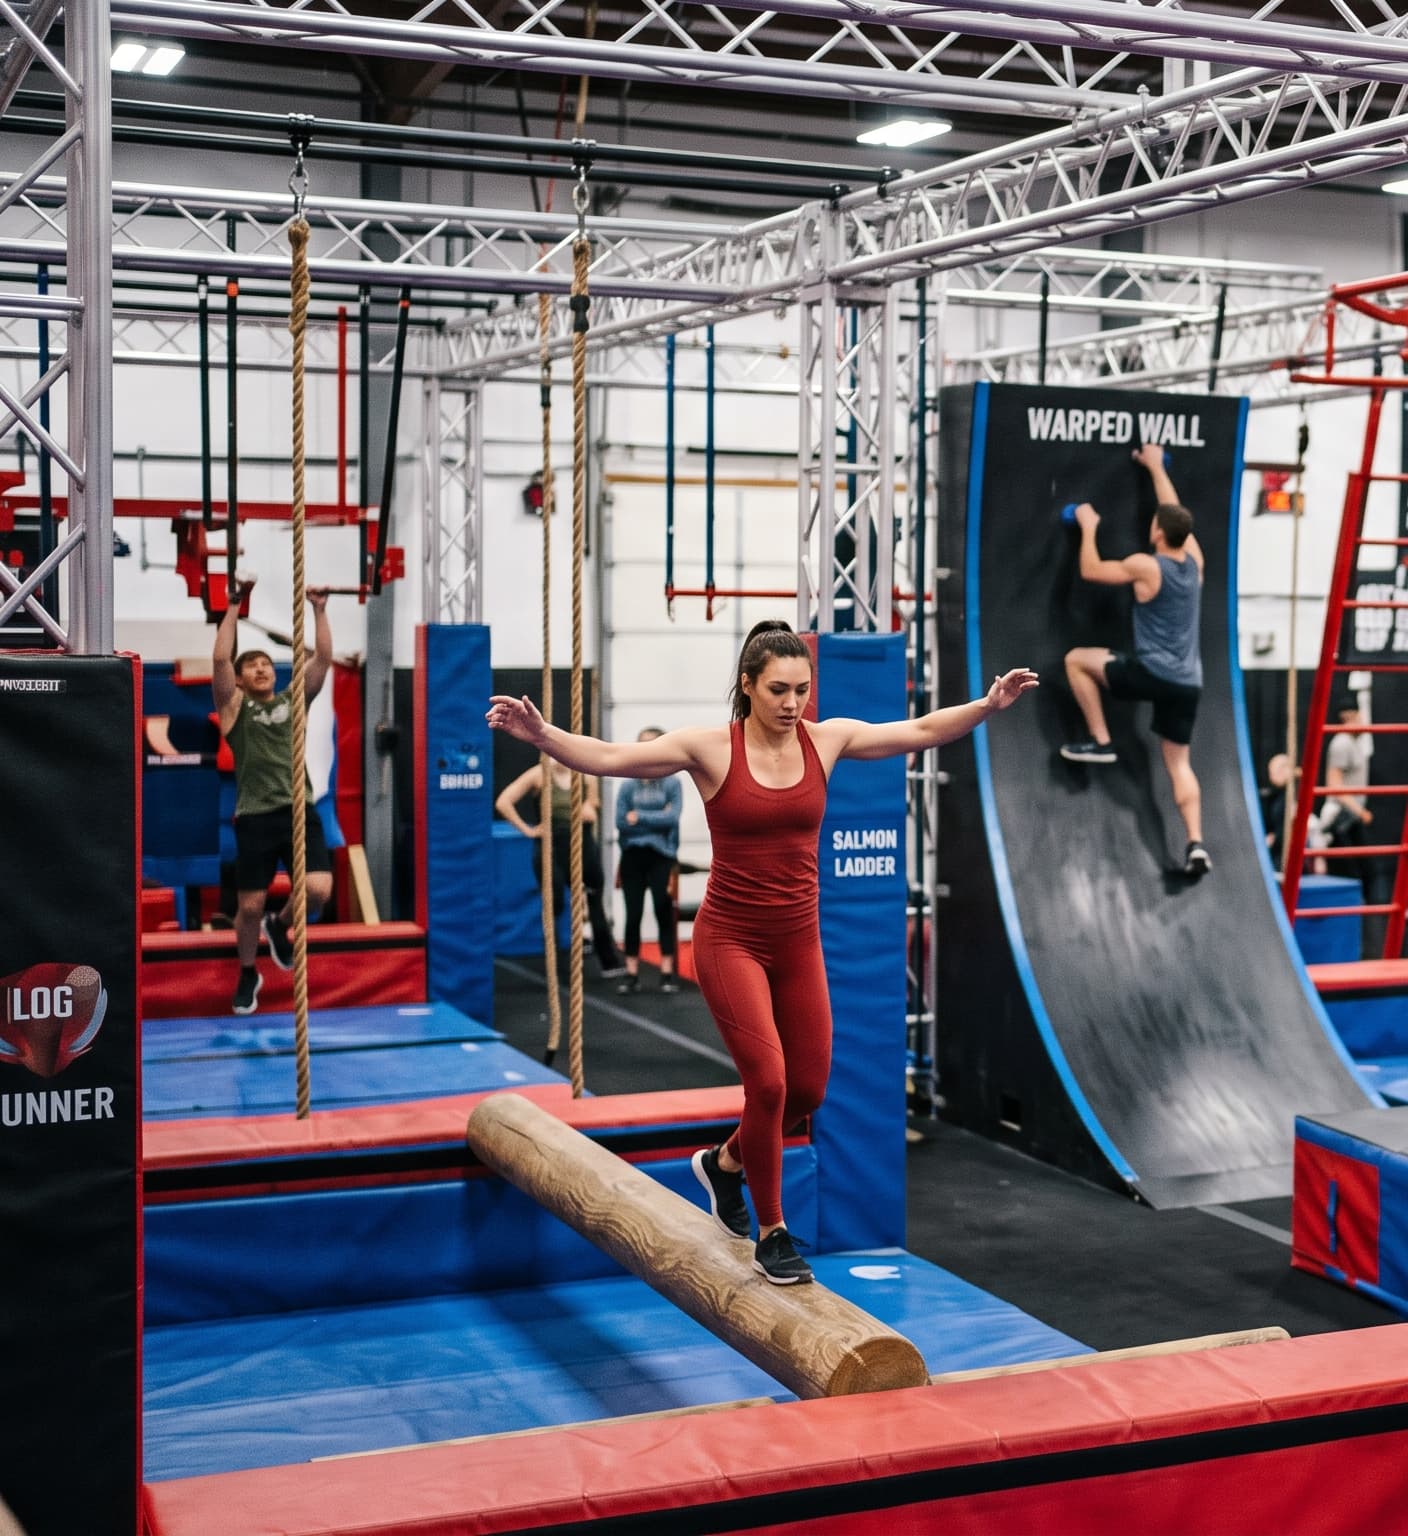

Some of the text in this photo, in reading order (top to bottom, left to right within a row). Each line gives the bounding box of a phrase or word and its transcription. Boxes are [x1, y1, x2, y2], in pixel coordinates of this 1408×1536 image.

[1027, 407, 1205, 447] WARPED WALL
[832, 829, 897, 850] SALMON
[834, 856, 896, 877] LADDER
[13, 985, 73, 1021] LOG
